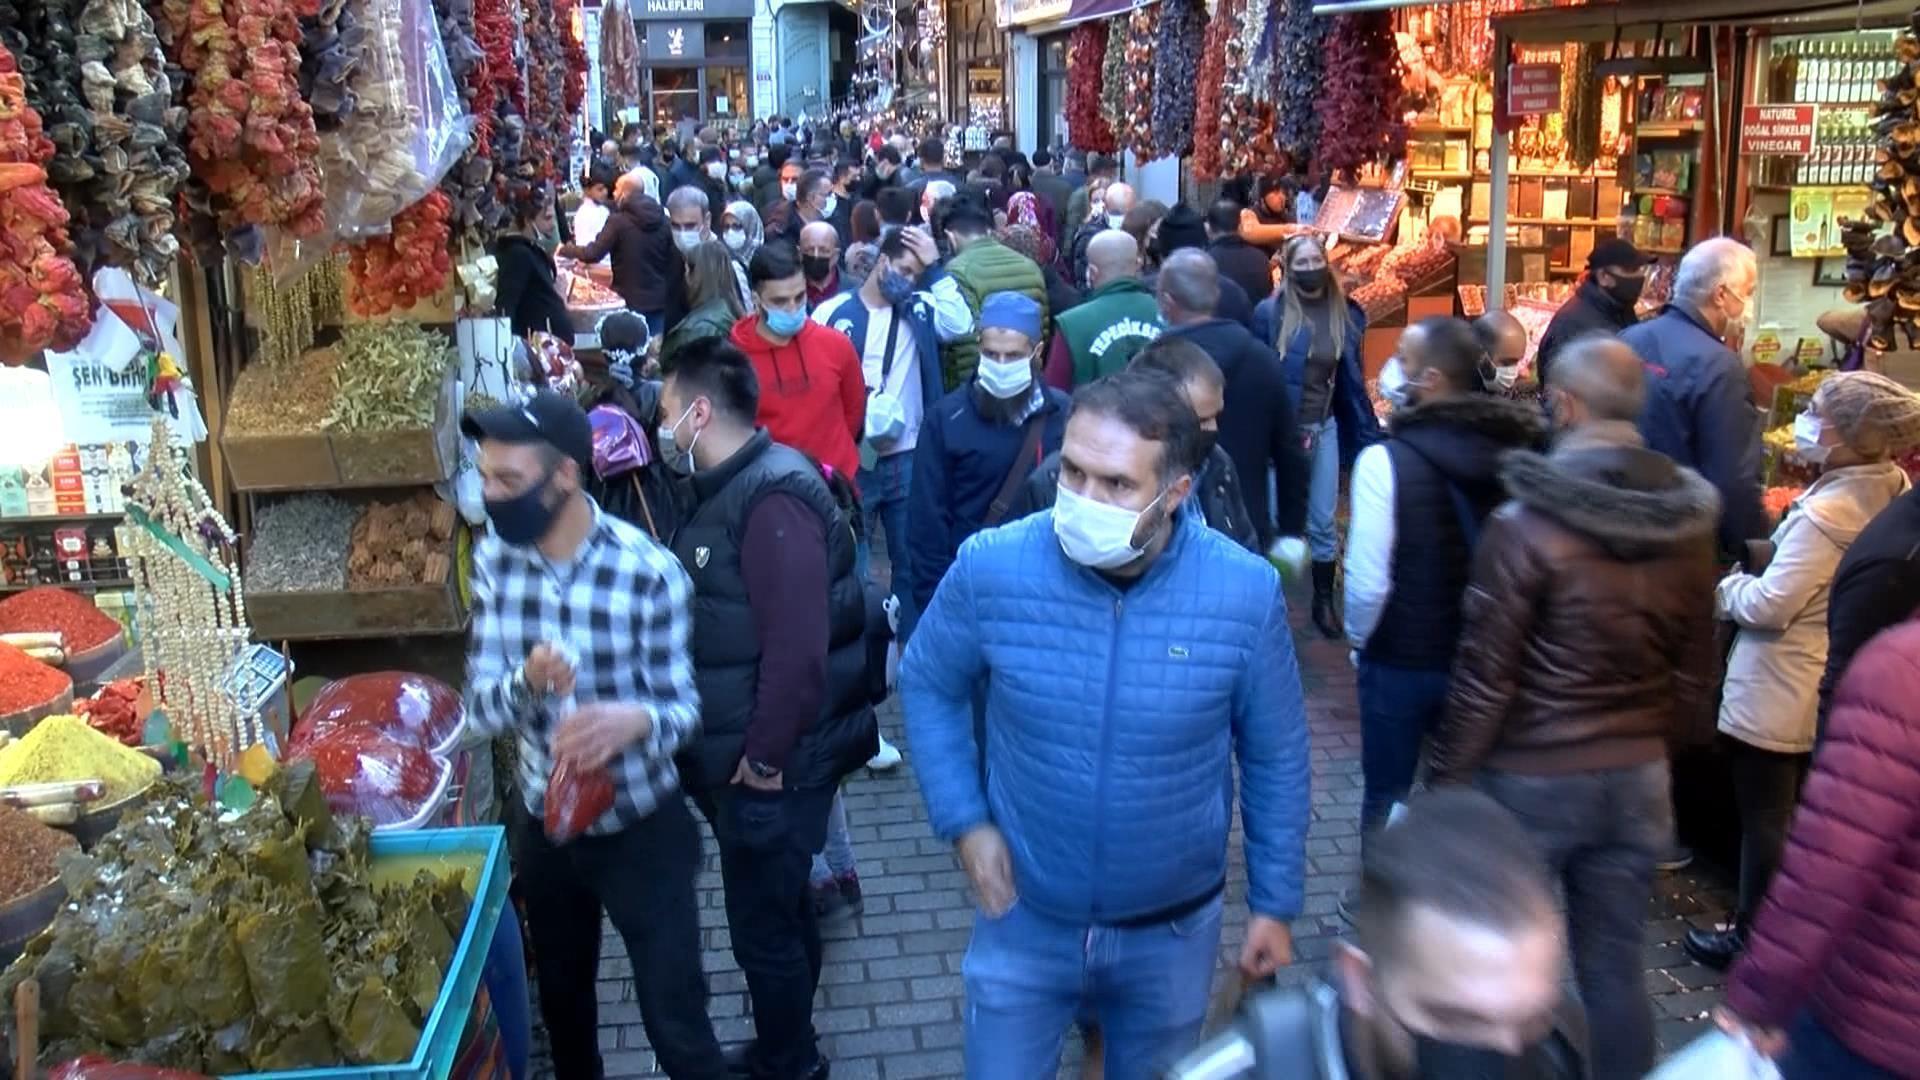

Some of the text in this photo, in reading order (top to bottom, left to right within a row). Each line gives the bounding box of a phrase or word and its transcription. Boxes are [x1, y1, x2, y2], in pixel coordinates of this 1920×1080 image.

[1759, 108, 1798, 121] NATUREL
[1744, 122, 1811, 137] DOĞAL SİRKELER
[1748, 140, 1802, 152] VINEGAR
